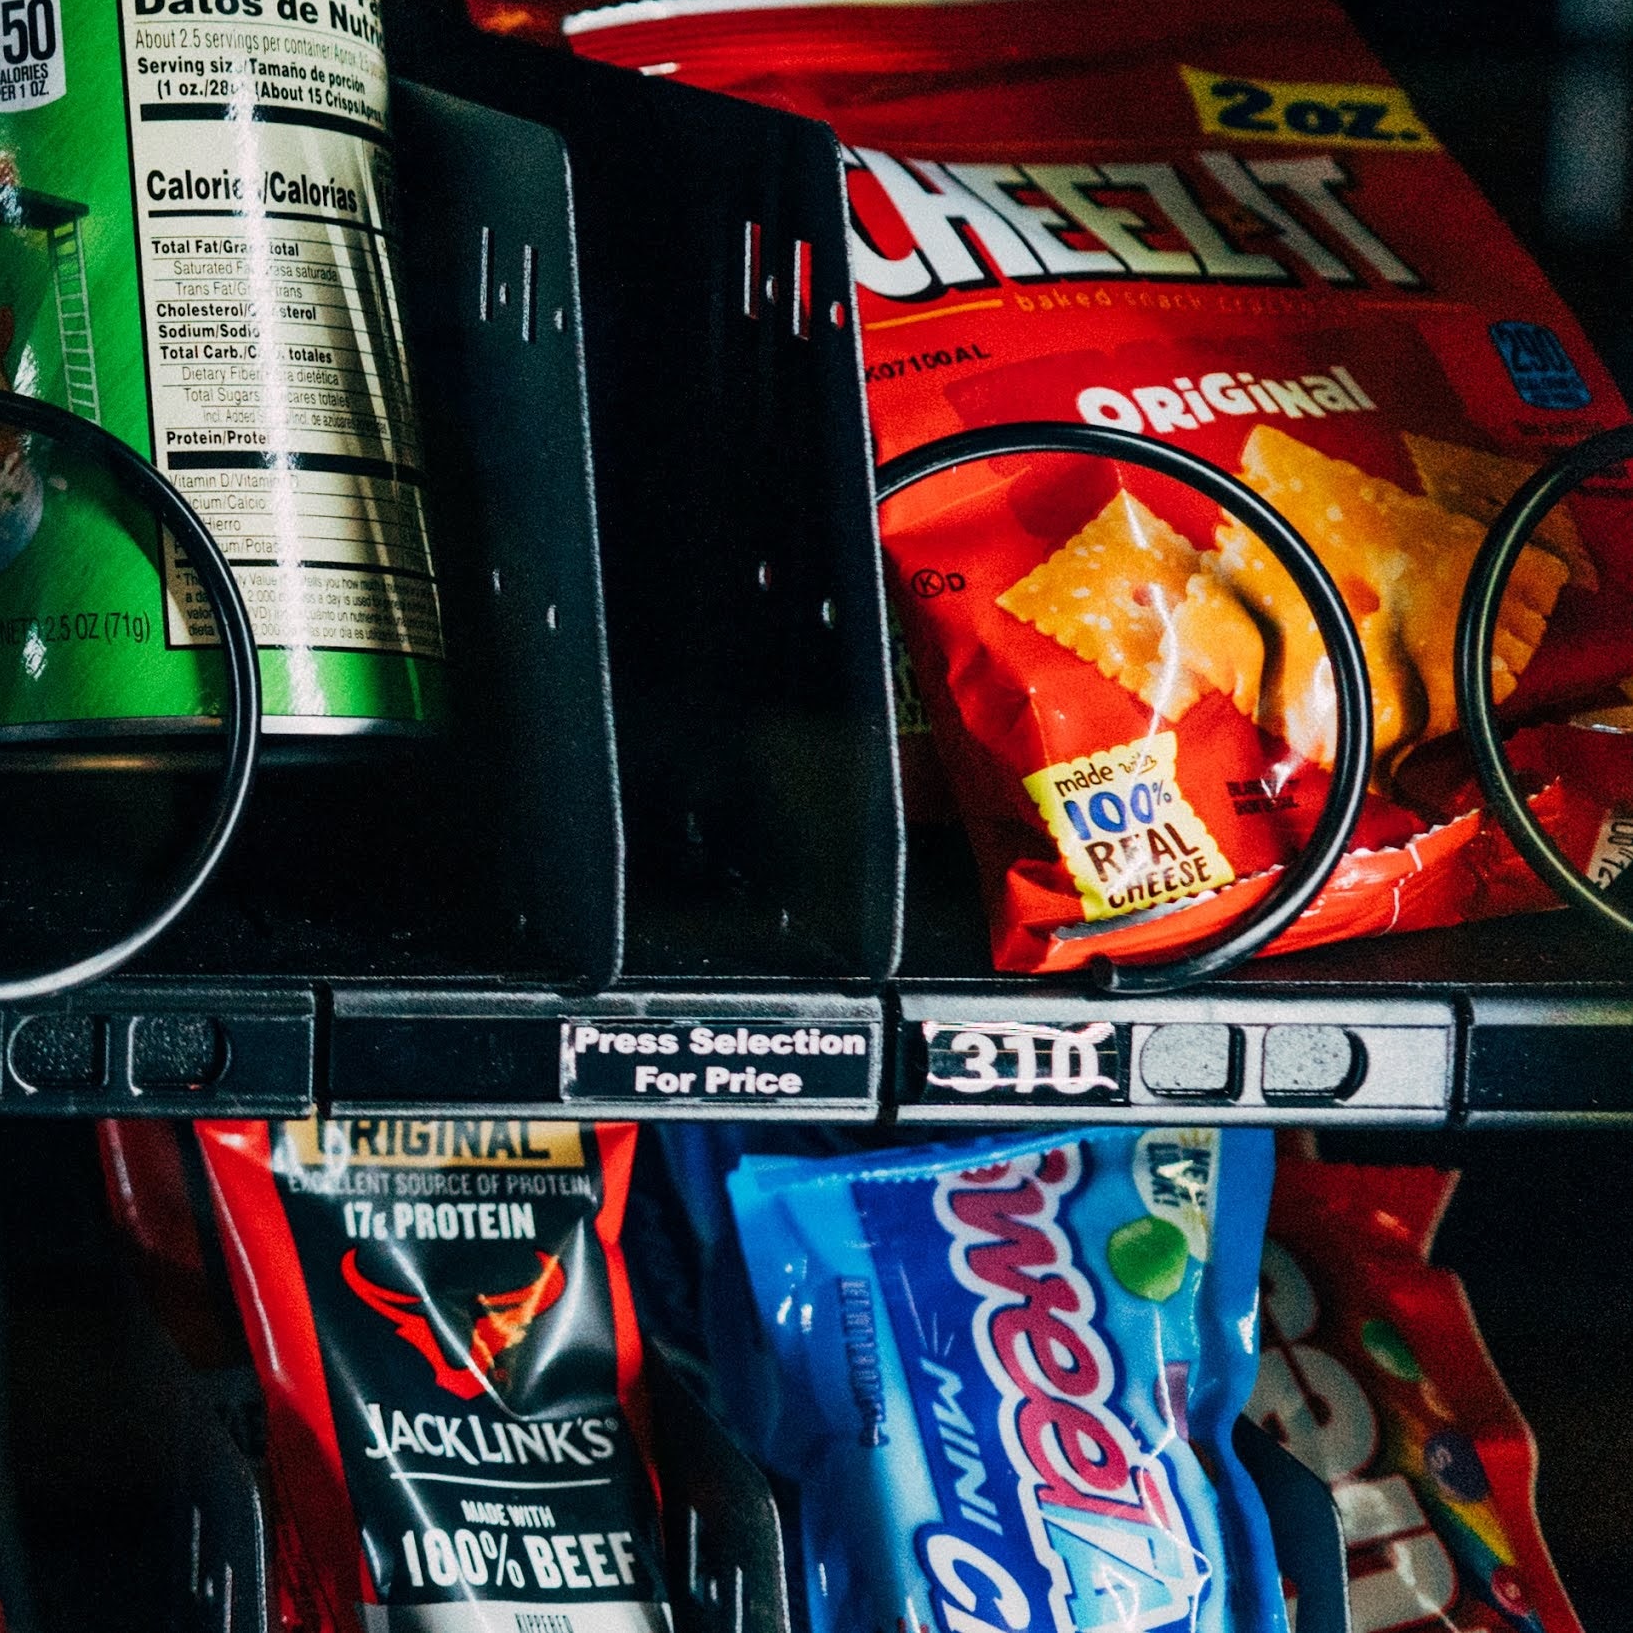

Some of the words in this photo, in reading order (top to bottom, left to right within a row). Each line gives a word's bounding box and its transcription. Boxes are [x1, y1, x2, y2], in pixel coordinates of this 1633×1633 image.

[135, 28, 176, 50] About
[179, 28, 202, 49] 2.5
[204, 29, 260, 53] servings
[261, 35, 282, 56] per
[30, 80, 50, 98] OZ.
[137, 55, 205, 77] Serving
[210, 56, 308, 82] siz/Tamaño
[310, 64, 327, 84] de
[328, 66, 367, 96] porción
[156, 78, 173, 100] (1
[254, 81, 305, 103] (About
[307, 86, 323, 105] 15
[151, 239, 191, 255] Total
[173, 259, 233, 276] Saturated
[175, 281, 210, 296] Trans
[1015, 287, 1112, 314] baked
[160, 344, 199, 360] Total
[288, 346, 333, 364] totales
[182, 367, 226, 384] Dietary
[184, 387, 214, 403] Total
[169, 473, 216, 488] Vitamin
[45, 614, 72, 643] 2.5
[75, 612, 101, 640] OZ
[104, 610, 151, 645] (71g)
[1054, 762, 1114, 798] made
[1064, 778, 1173, 841] 100%
[1085, 821, 1201, 883] REAL
[1107, 856, 1214, 910] CHEESE
[574, 1026, 679, 1055] Press
[689, 1026, 866, 1055] Selection
[950, 1031, 1101, 1096] 310
[635, 1066, 698, 1094] For
[705, 1066, 803, 1094] Price
[395, 1174, 471, 1197] SOURCE
[476, 1174, 501, 1196] OF
[506, 1174, 592, 1197] PROTEIN
[393, 1202, 537, 1240] PROTEIN
[365, 1403, 481, 1466] JACK
[468, 1415, 615, 1466] LINK'S
[921, 1360, 1005, 1537] MINI
[460, 1499, 510, 1527] MADE
[506, 1505, 557, 1528] WITH
[401, 1528, 526, 1589] 100%
[522, 1531, 637, 1589] BEEF
